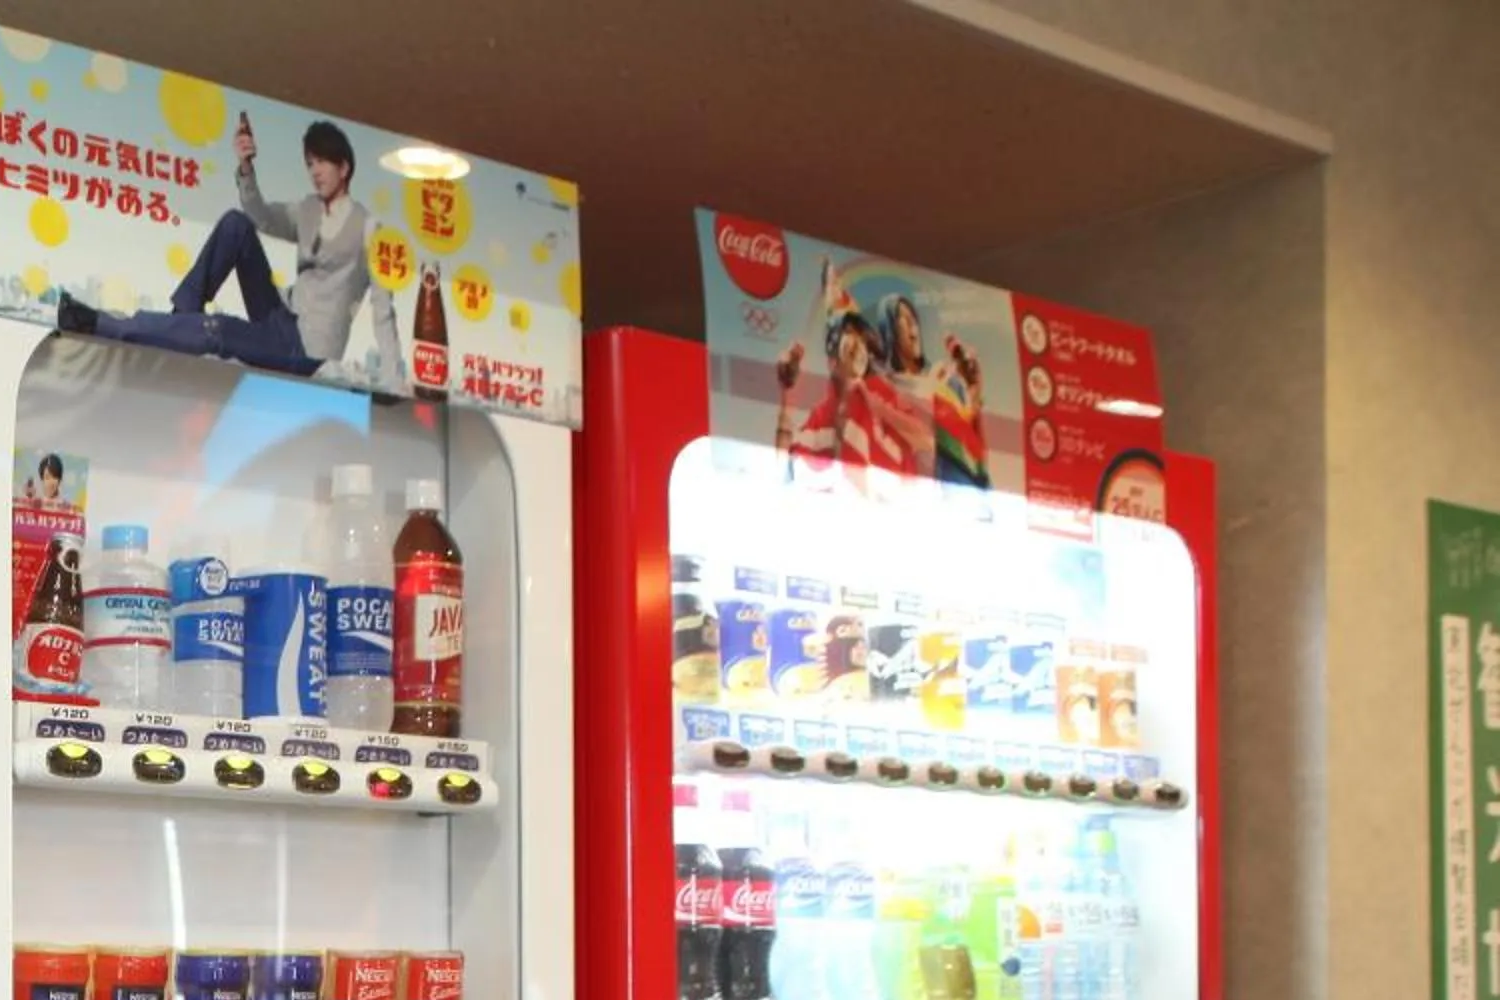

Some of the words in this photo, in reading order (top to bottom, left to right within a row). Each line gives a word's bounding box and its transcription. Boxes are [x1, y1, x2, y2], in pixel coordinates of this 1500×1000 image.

[718, 224, 784, 268] Coca-Cola
[337, 598, 392, 615] POCA
[198, 618, 244, 631] POCA
[337, 613, 392, 631] SWEA
[198, 629, 244, 643] SWEA
